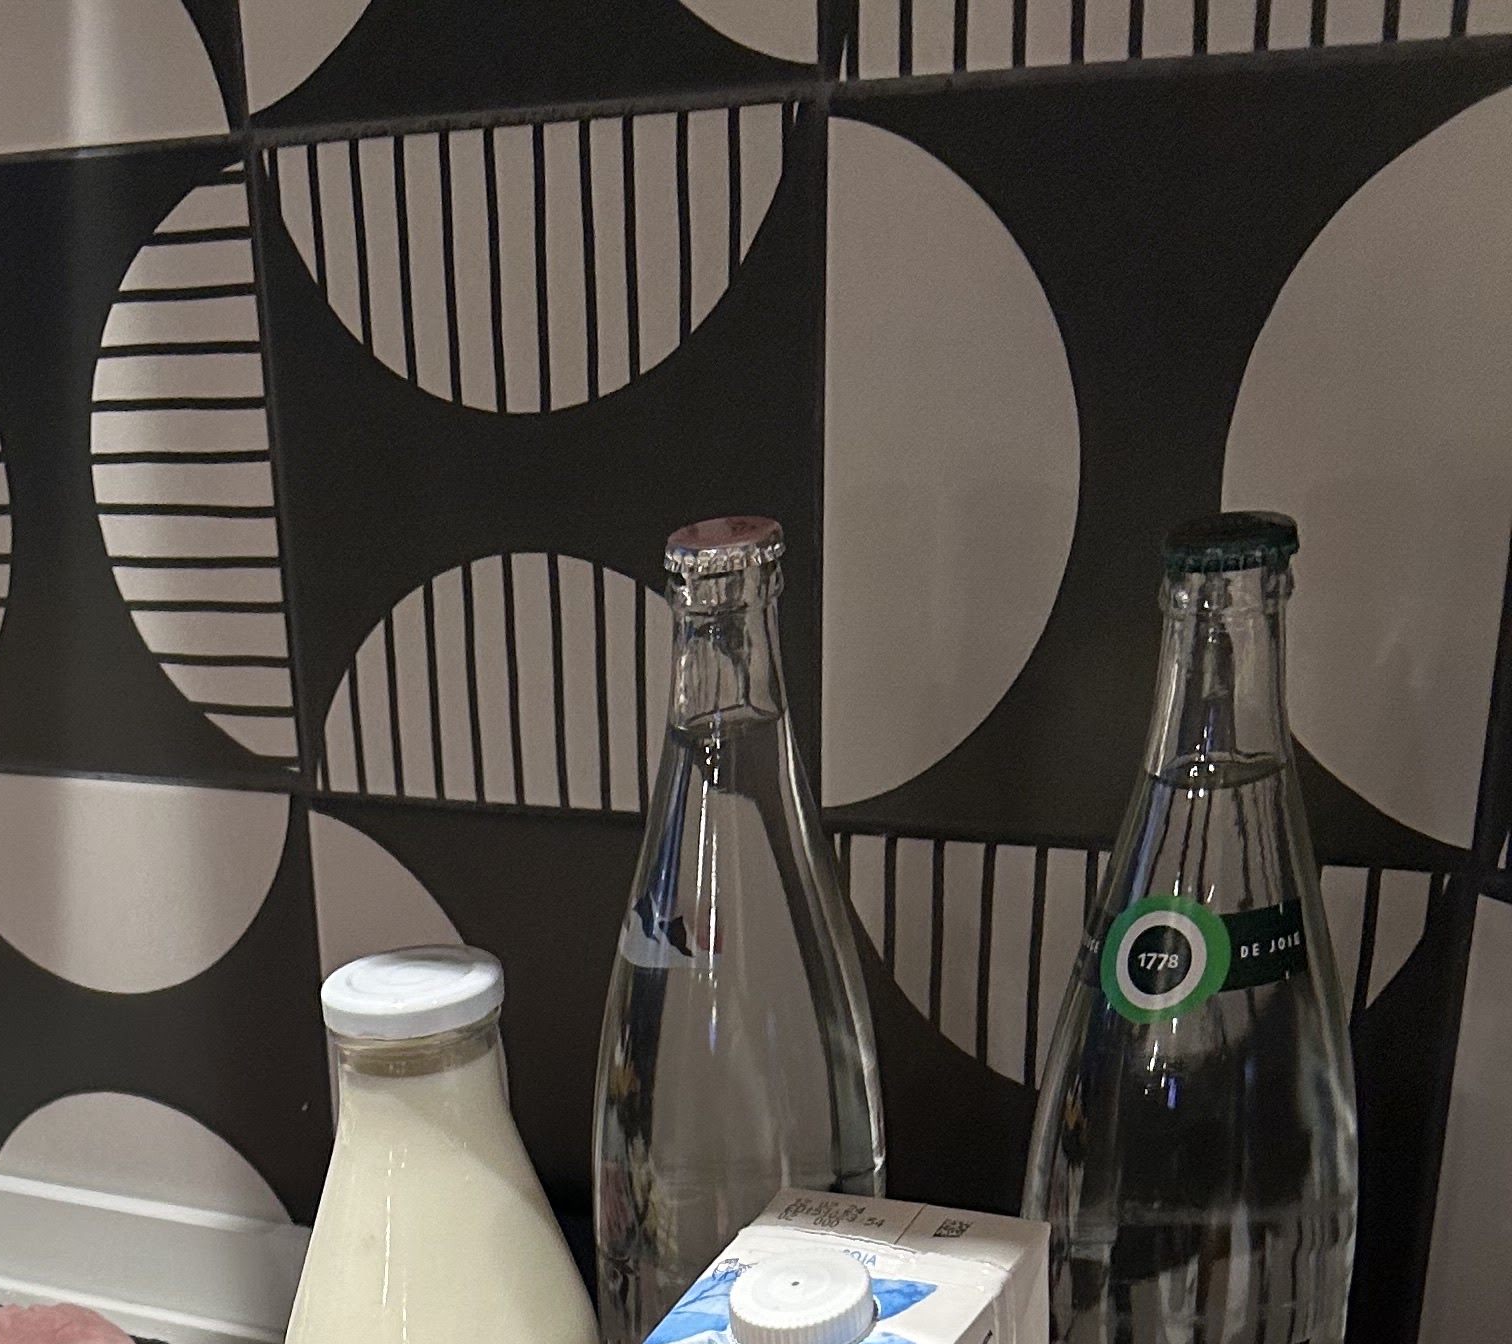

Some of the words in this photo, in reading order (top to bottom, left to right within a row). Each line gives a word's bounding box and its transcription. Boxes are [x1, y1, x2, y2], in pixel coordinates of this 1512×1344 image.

[1240, 943, 1260, 958] DE
[1269, 932, 1301, 953] JOIE
[1138, 952, 1179, 971] 1778
